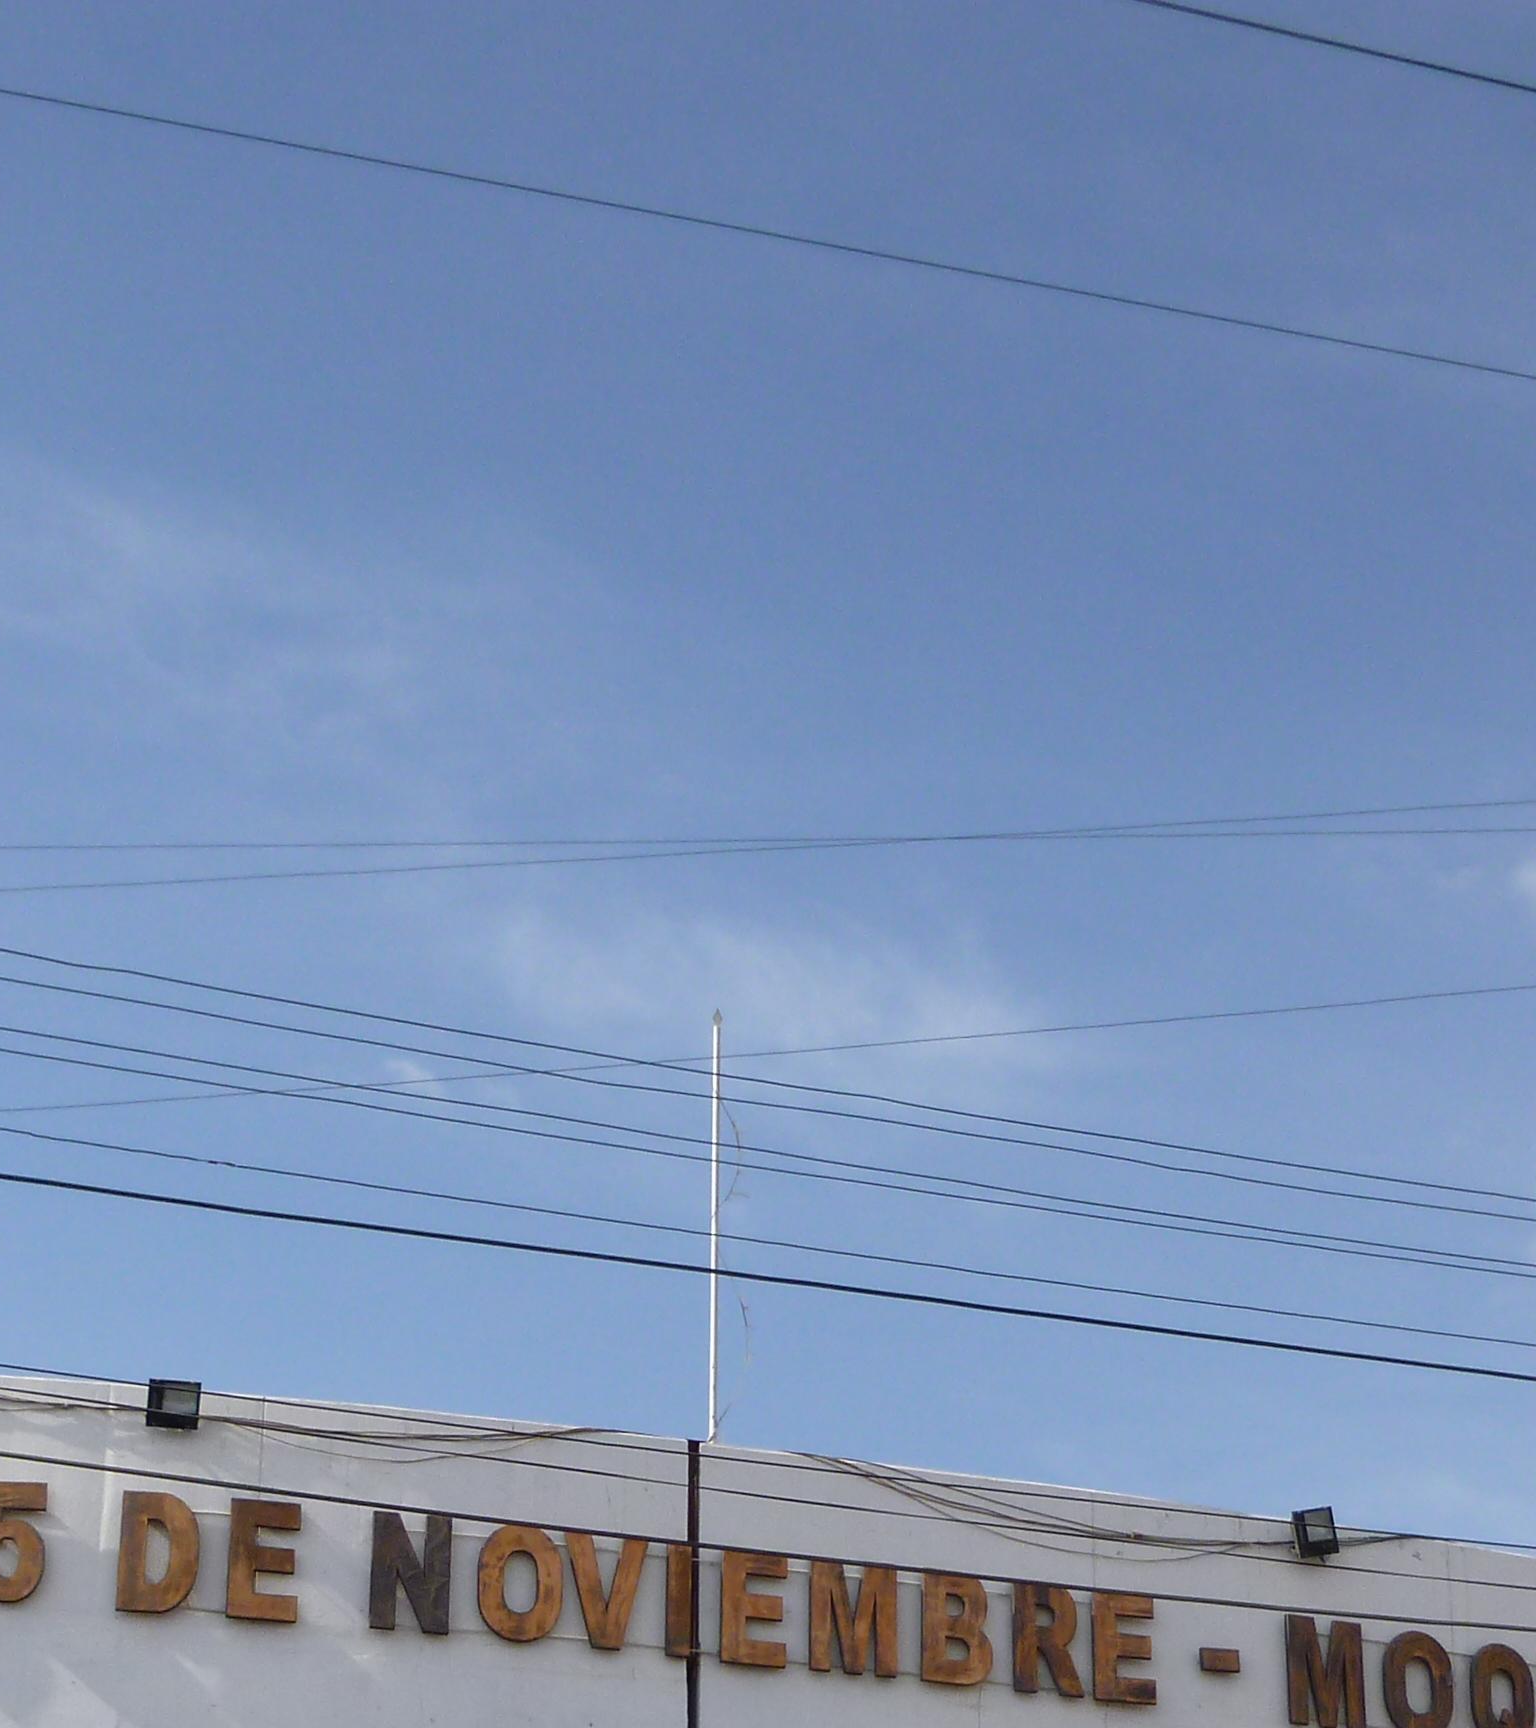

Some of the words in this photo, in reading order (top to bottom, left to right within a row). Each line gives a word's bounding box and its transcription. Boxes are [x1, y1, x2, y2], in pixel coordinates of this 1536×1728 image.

[115, 1489, 303, 1623] DE
[369, 1509, 1158, 1706] NOVIEMBRE
[1199, 1647, 1241, 1673] -
